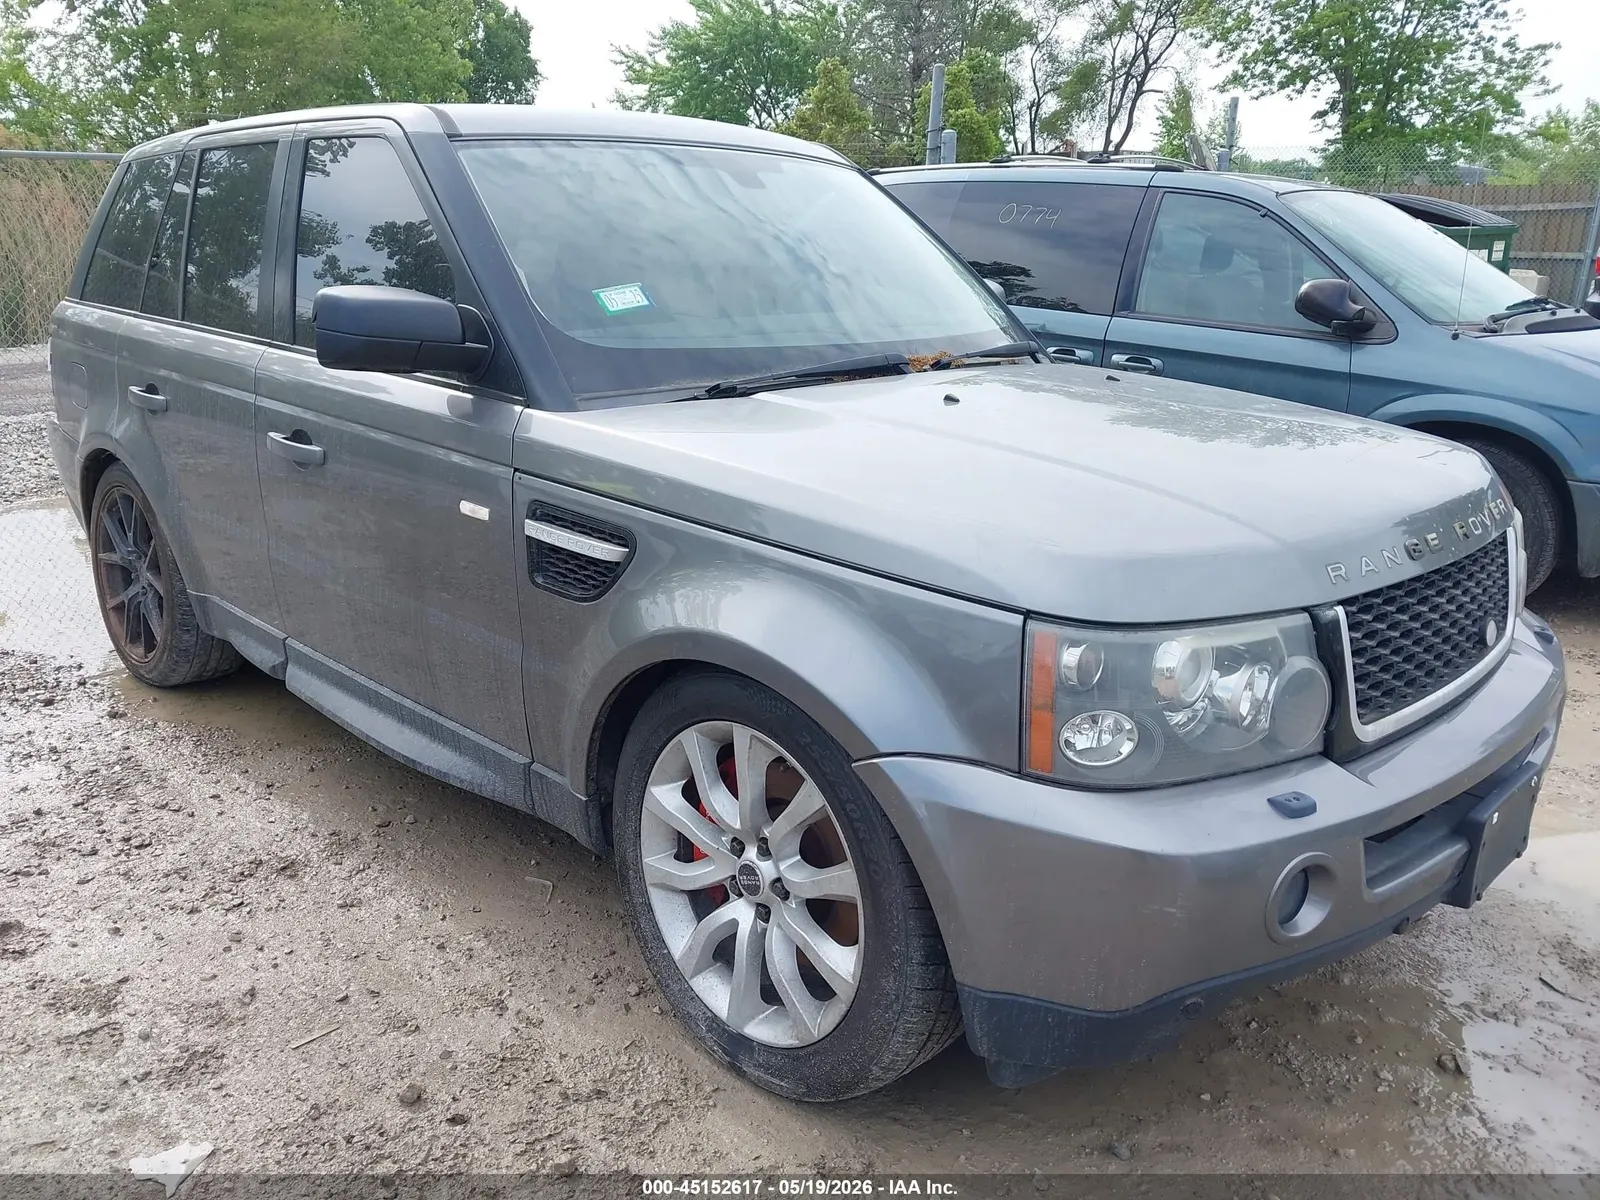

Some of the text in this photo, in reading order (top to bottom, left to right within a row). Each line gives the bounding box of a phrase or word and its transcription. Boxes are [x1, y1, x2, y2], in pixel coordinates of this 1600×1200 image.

[998, 202, 1063, 229] 0774
[527, 524, 611, 558] RANGE ROVER
[1325, 498, 1508, 585] RANGE ROVER
